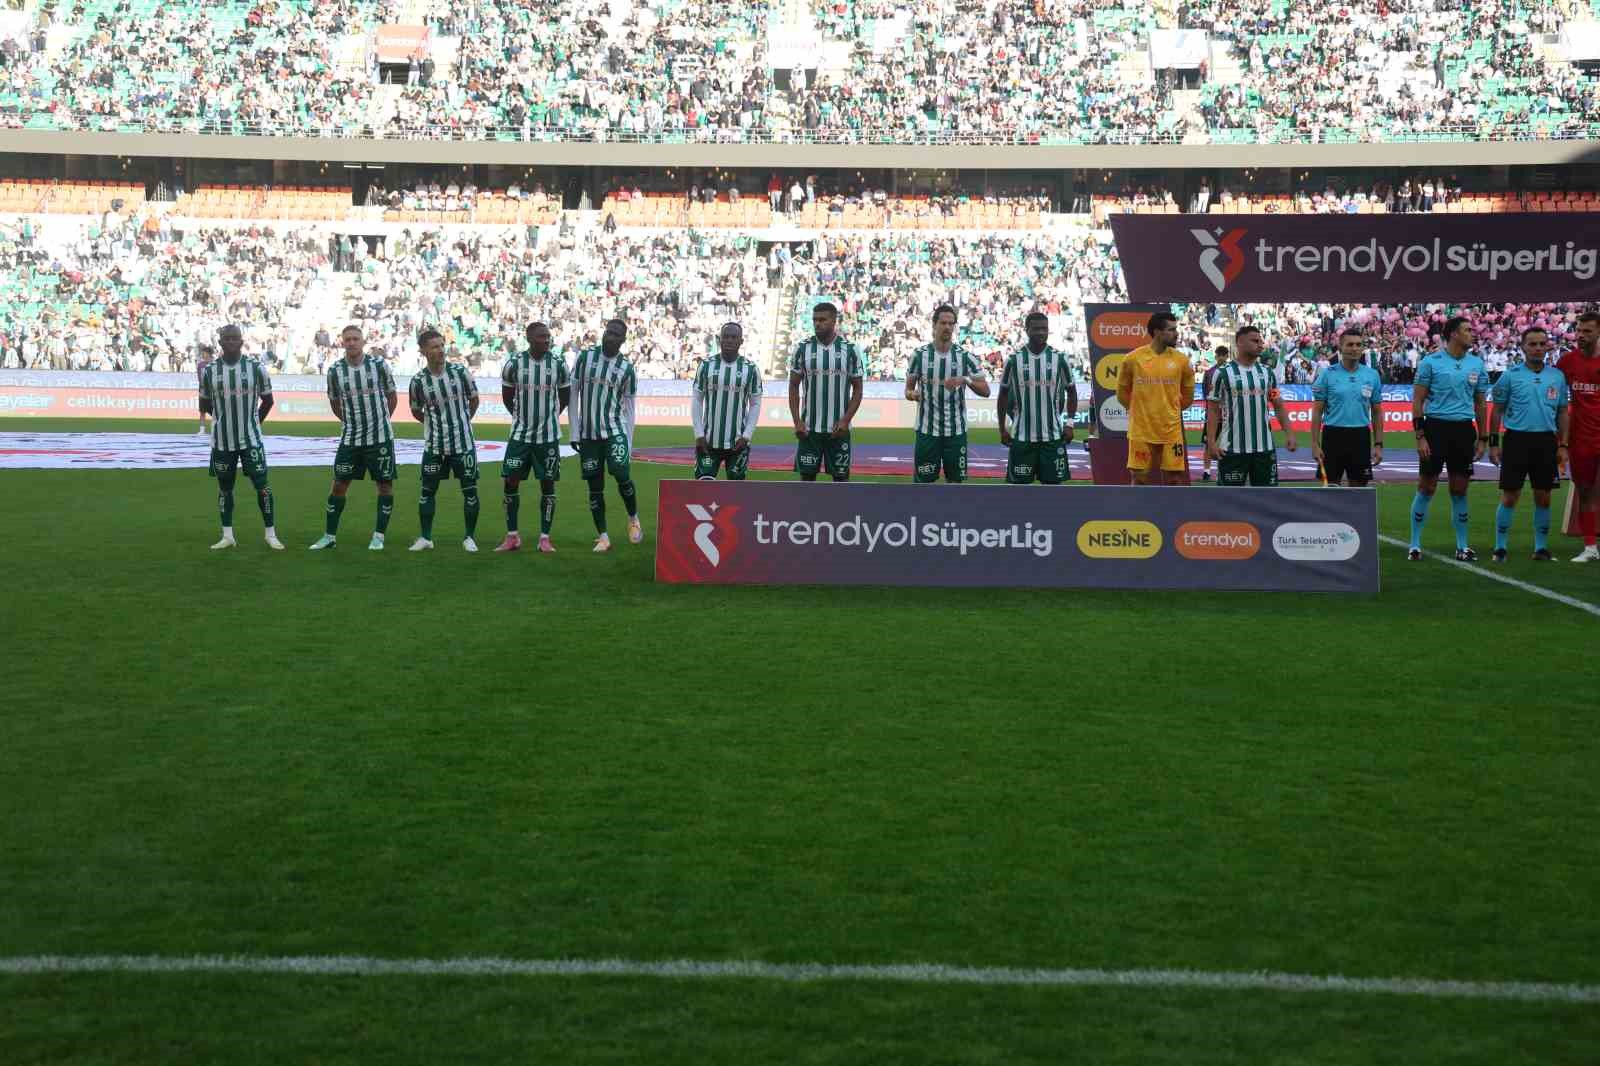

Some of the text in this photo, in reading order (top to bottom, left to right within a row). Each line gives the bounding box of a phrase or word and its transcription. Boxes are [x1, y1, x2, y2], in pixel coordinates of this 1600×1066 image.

[1255, 238, 1598, 280] trendyol SüperLig
[250, 448, 264, 463] 91
[611, 444, 625, 457] 26
[1172, 443, 1183, 457] 13
[376, 456, 391, 470] 77
[462, 454, 474, 469] 10
[545, 456, 557, 469] 17
[800, 455, 818, 465] REY
[835, 454, 849, 467] 22
[959, 457, 966, 469] 8
[1054, 458, 1065, 471] 15
[336, 463, 354, 473] REY
[424, 464, 441, 473] REY
[918, 463, 937, 474] REY
[1014, 466, 1033, 474] REY
[753, 513, 1053, 556] trendyol SüperLig
[1184, 532, 1253, 549] trendyol
[1277, 535, 1338, 545] Türk Telekom
